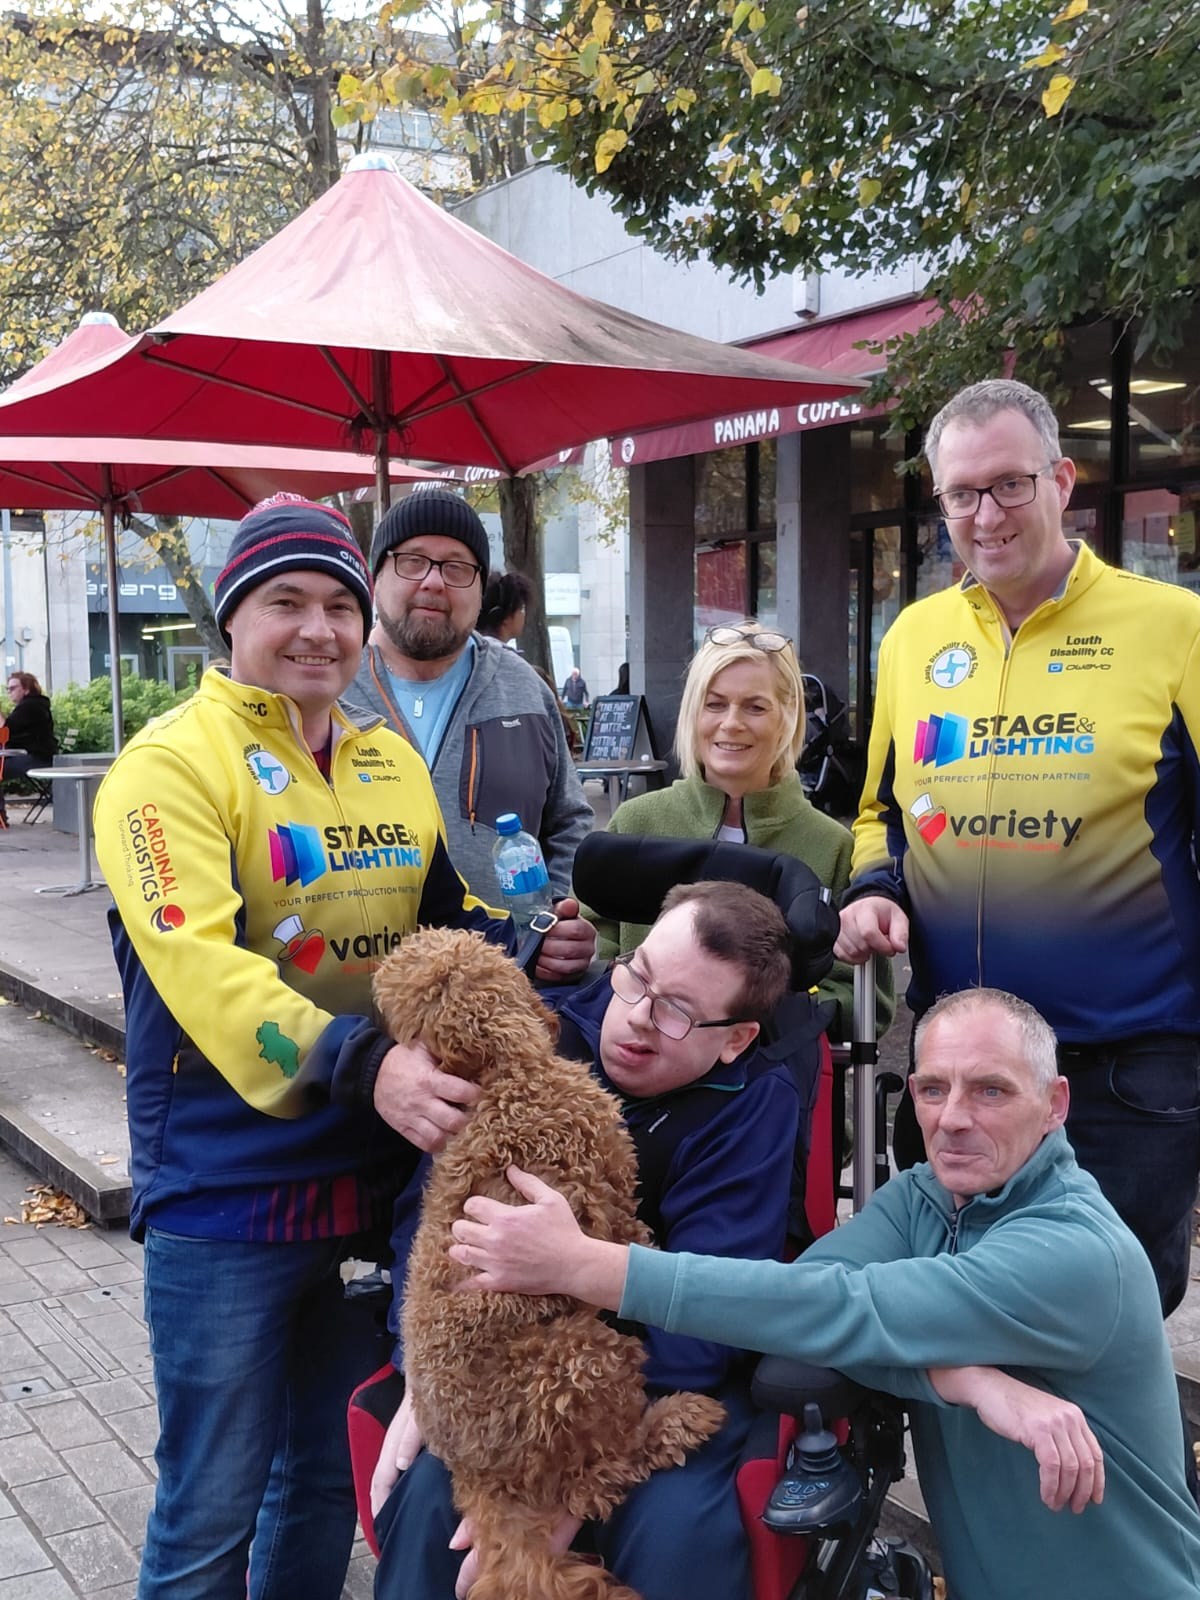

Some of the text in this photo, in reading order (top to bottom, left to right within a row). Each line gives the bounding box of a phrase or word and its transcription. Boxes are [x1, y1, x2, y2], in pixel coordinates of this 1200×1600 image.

[714, 408, 780, 444] PANAMA
[1050, 647, 1114, 657] Disability CC
[1066, 635, 1102, 646] Louth
[969, 735, 1095, 759] LIGHTING
[934, 775, 974, 783] PERFECT
[976, 773, 1038, 783] PRDUCTION
[1042, 772, 1090, 781] PARTNER
[950, 809, 1082, 847] variety
[126, 808, 160, 903] LOGISTICS
[141, 803, 179, 898] CARDINAL
[328, 847, 422, 872] LIGHTING
[273, 897, 302, 908] YOUR
[305, 890, 345, 904] PERFECT
[329, 925, 406, 962] varie
